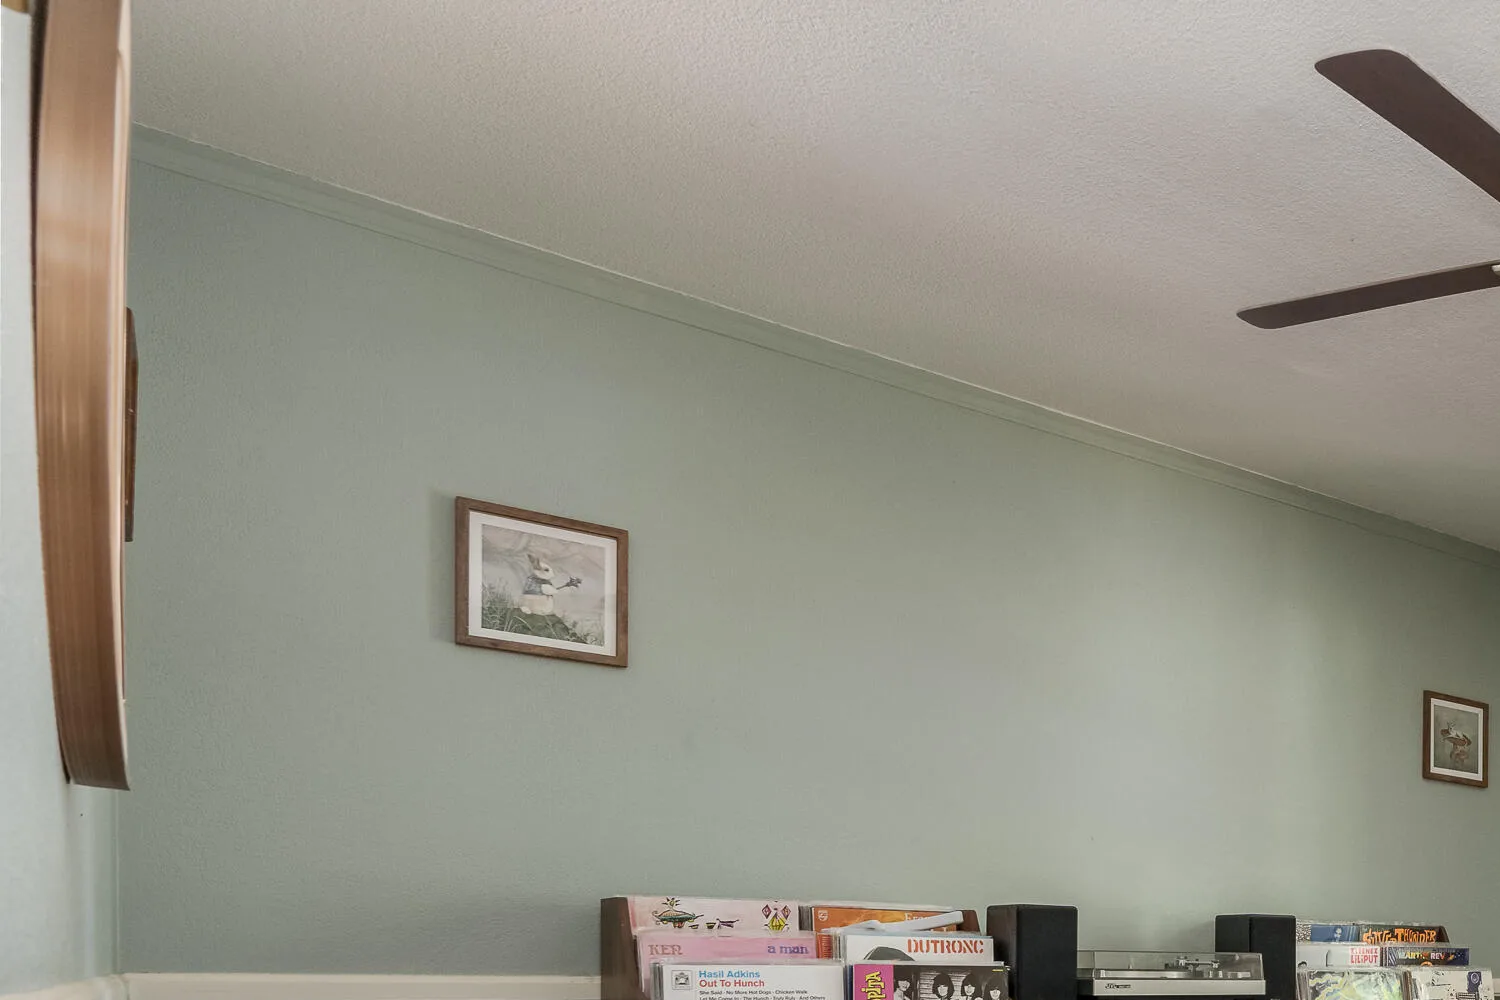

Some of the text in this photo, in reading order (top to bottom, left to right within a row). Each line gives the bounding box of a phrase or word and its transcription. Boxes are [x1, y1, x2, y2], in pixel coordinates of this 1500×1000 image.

[779, 945, 809, 954] man
[907, 939, 984, 954] DUTRONC
[699, 970, 761, 979] Hasil Adkins
[699, 979, 765, 988] Out To Hunch
